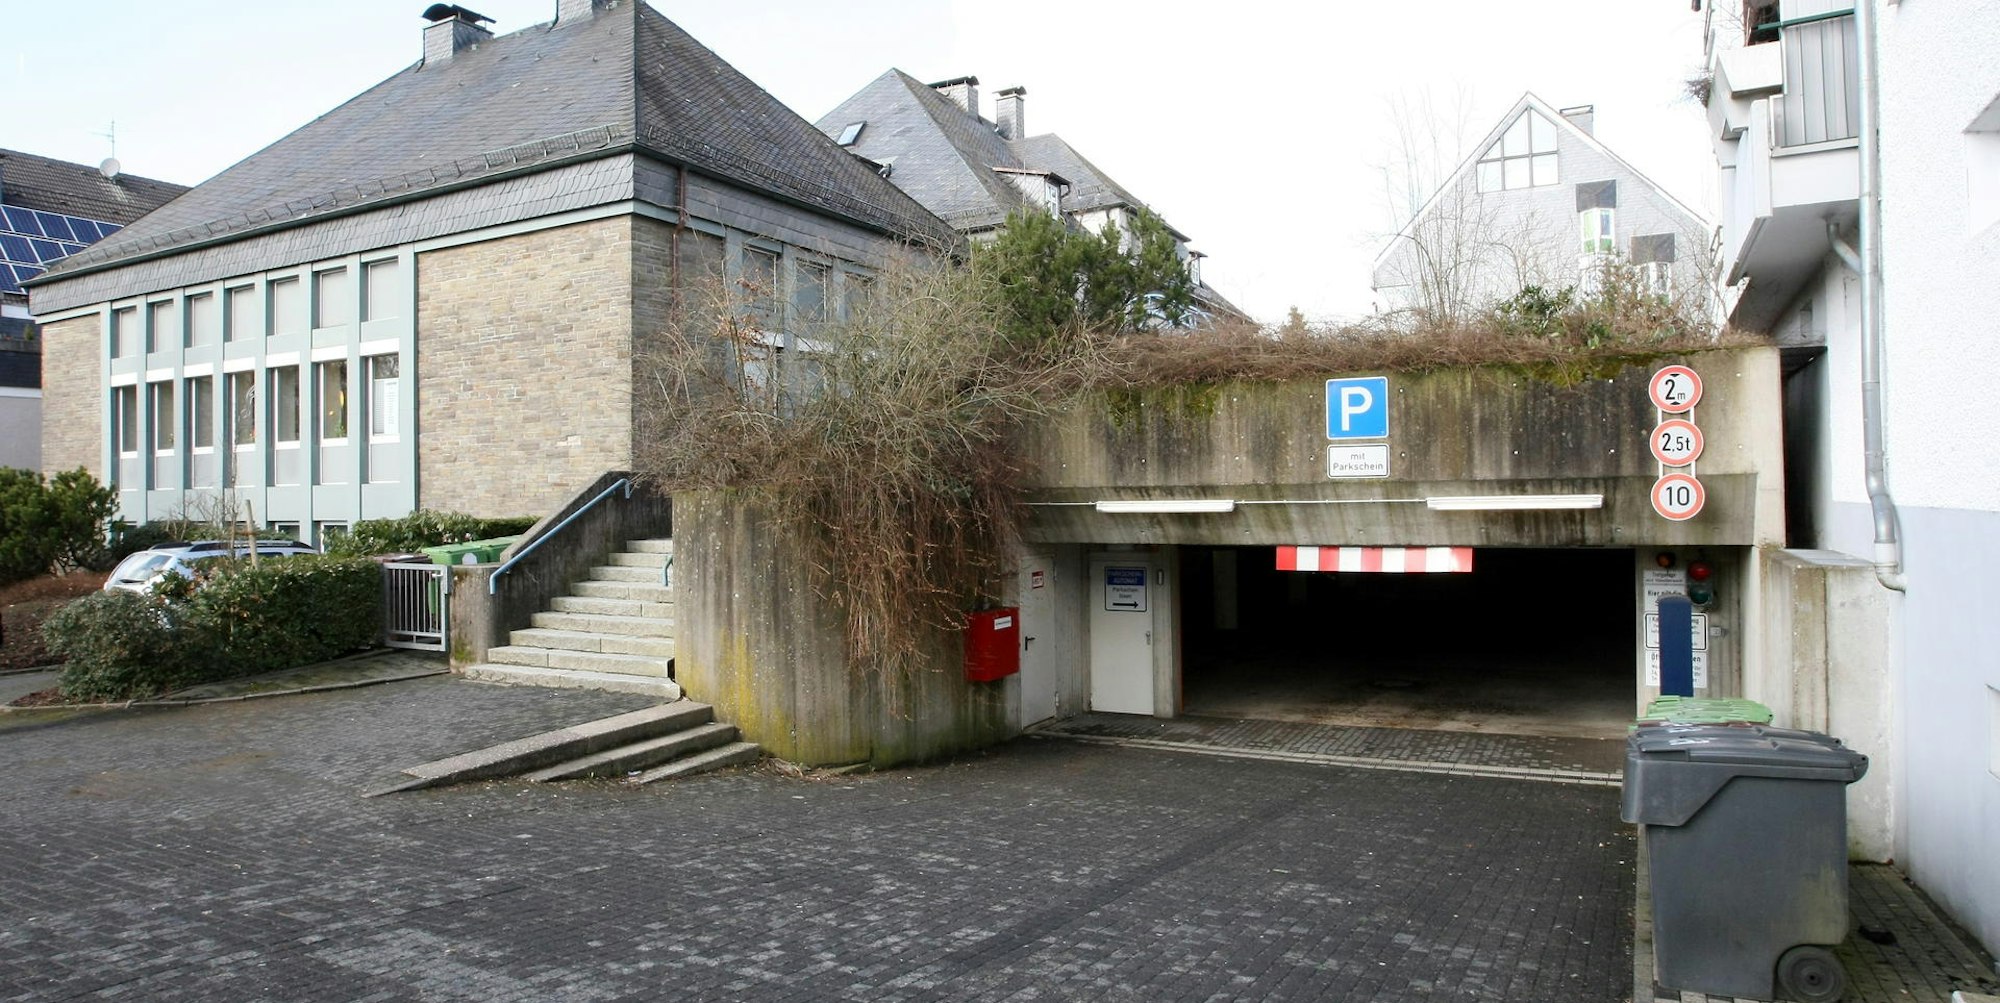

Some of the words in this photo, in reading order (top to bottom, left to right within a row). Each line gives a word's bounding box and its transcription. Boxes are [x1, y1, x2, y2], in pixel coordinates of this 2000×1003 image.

[1665, 379, 1675, 400] 2
[1677, 392, 1686, 400] m
[1341, 386, 1373, 432] P
[1350, 452, 1366, 460] mit
[1332, 462, 1384, 471] Parkschein
[1665, 486, 1690, 506] 10
